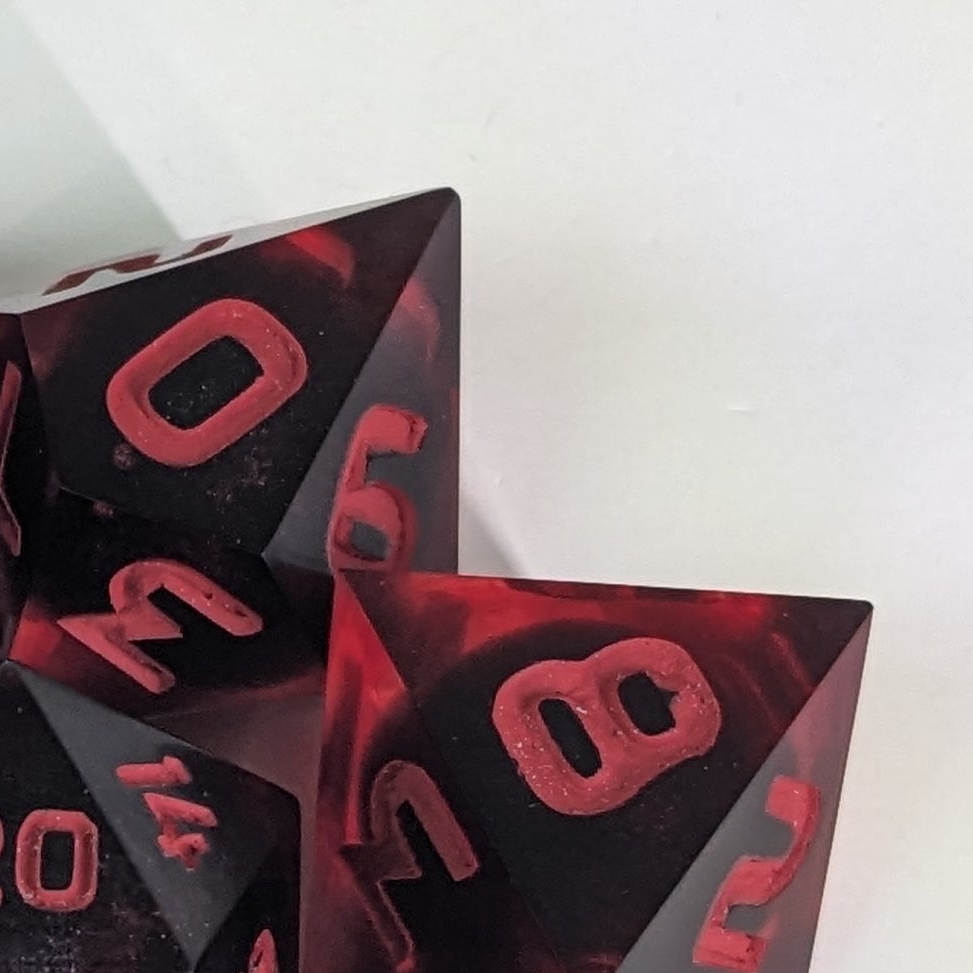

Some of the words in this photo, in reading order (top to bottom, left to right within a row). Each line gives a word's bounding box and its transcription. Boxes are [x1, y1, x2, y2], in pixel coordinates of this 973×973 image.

[106, 298, 307, 467] 0
[329, 403, 428, 573] 6
[492, 637, 721, 816] 8
[115, 755, 218, 871] 14
